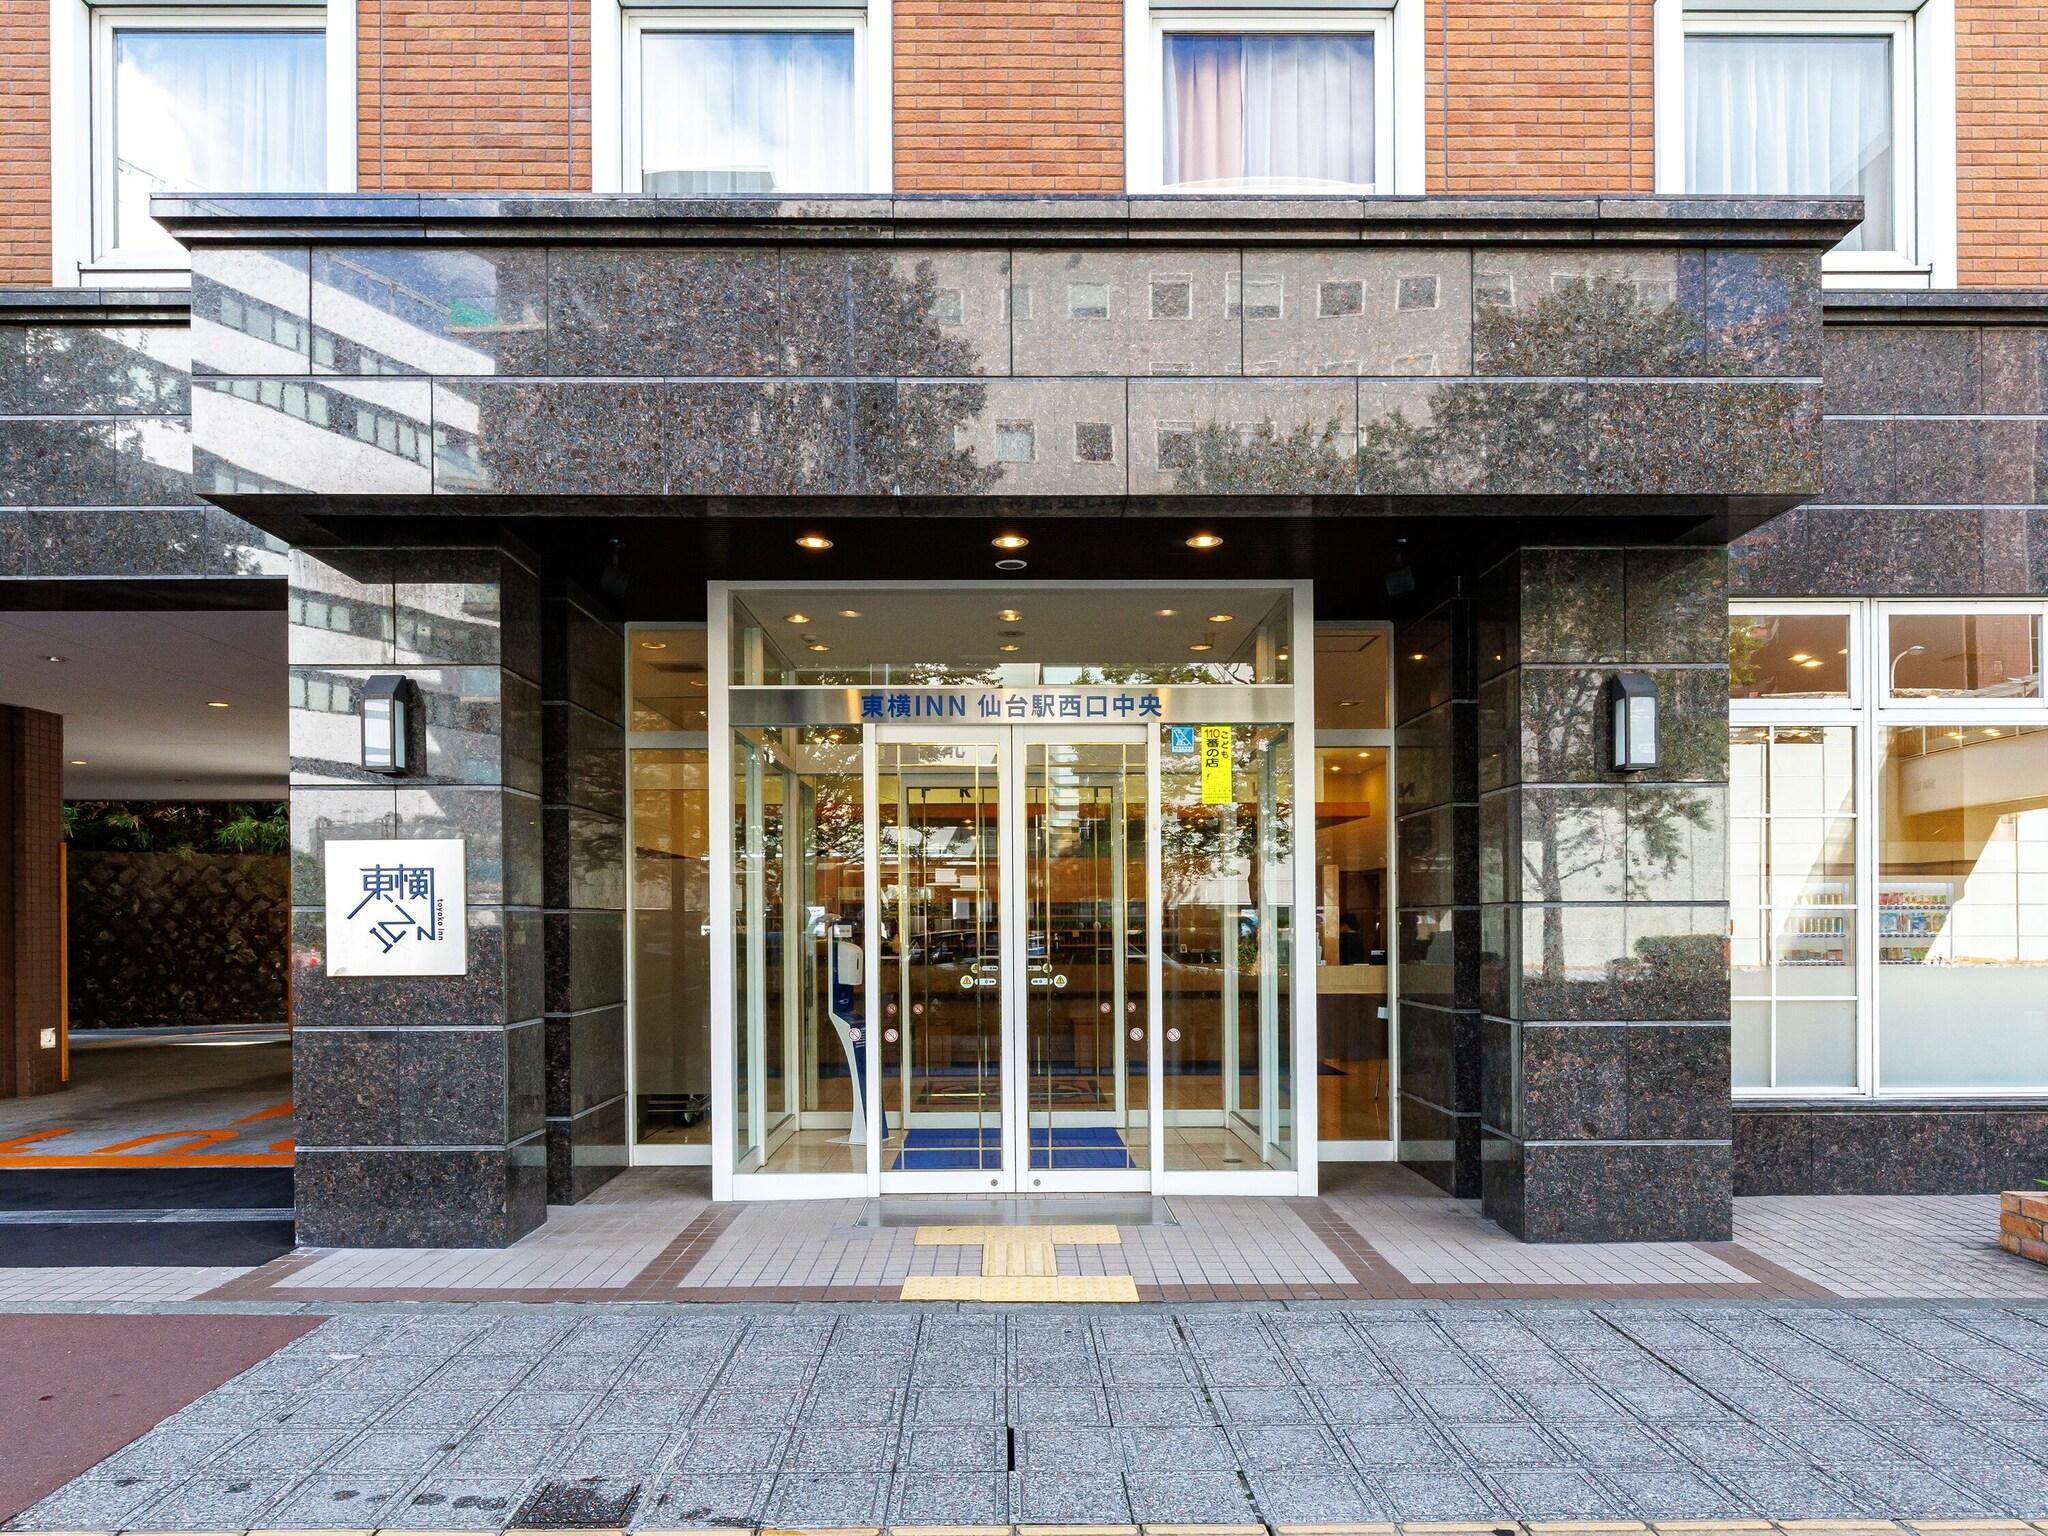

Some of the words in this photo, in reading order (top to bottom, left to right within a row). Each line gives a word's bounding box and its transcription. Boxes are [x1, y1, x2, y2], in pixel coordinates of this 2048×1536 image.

[861, 695, 966, 718] 東横INN
[977, 694, 1163, 718] 仙台駅西口中央
[1204, 728, 1220, 768] 110番の店
[1221, 731, 1229, 759] こども
[436, 899, 444, 926] toyoko
